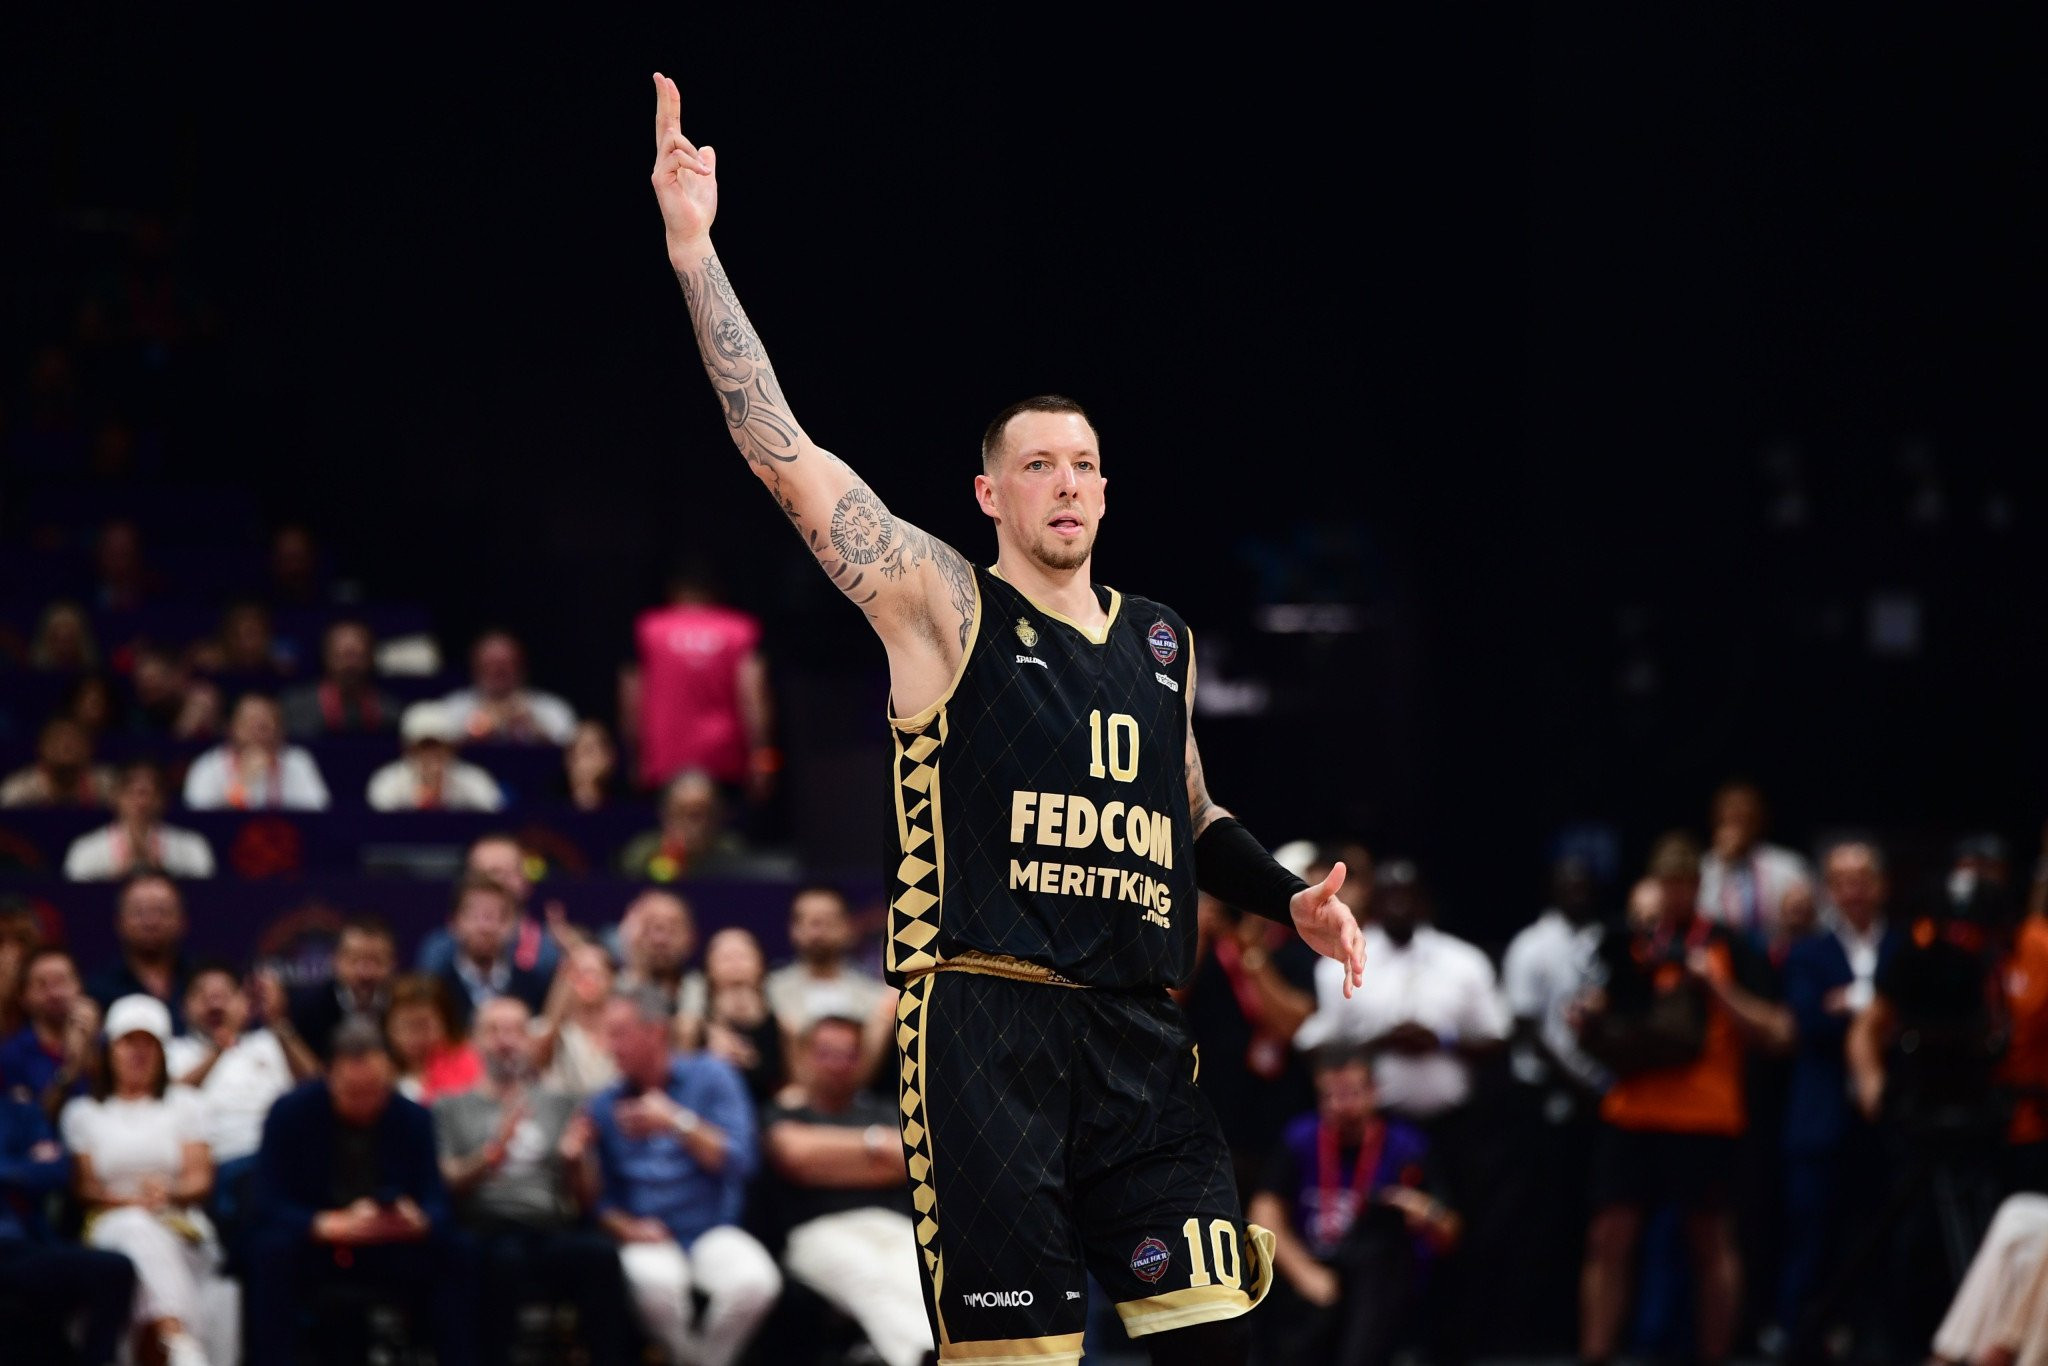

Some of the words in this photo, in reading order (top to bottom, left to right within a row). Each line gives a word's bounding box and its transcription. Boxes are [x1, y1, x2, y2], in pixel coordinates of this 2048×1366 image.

[1089, 709, 1140, 783] 10
[1010, 790, 1172, 869] FEDCOM
[1182, 1217, 1241, 1290] 10
